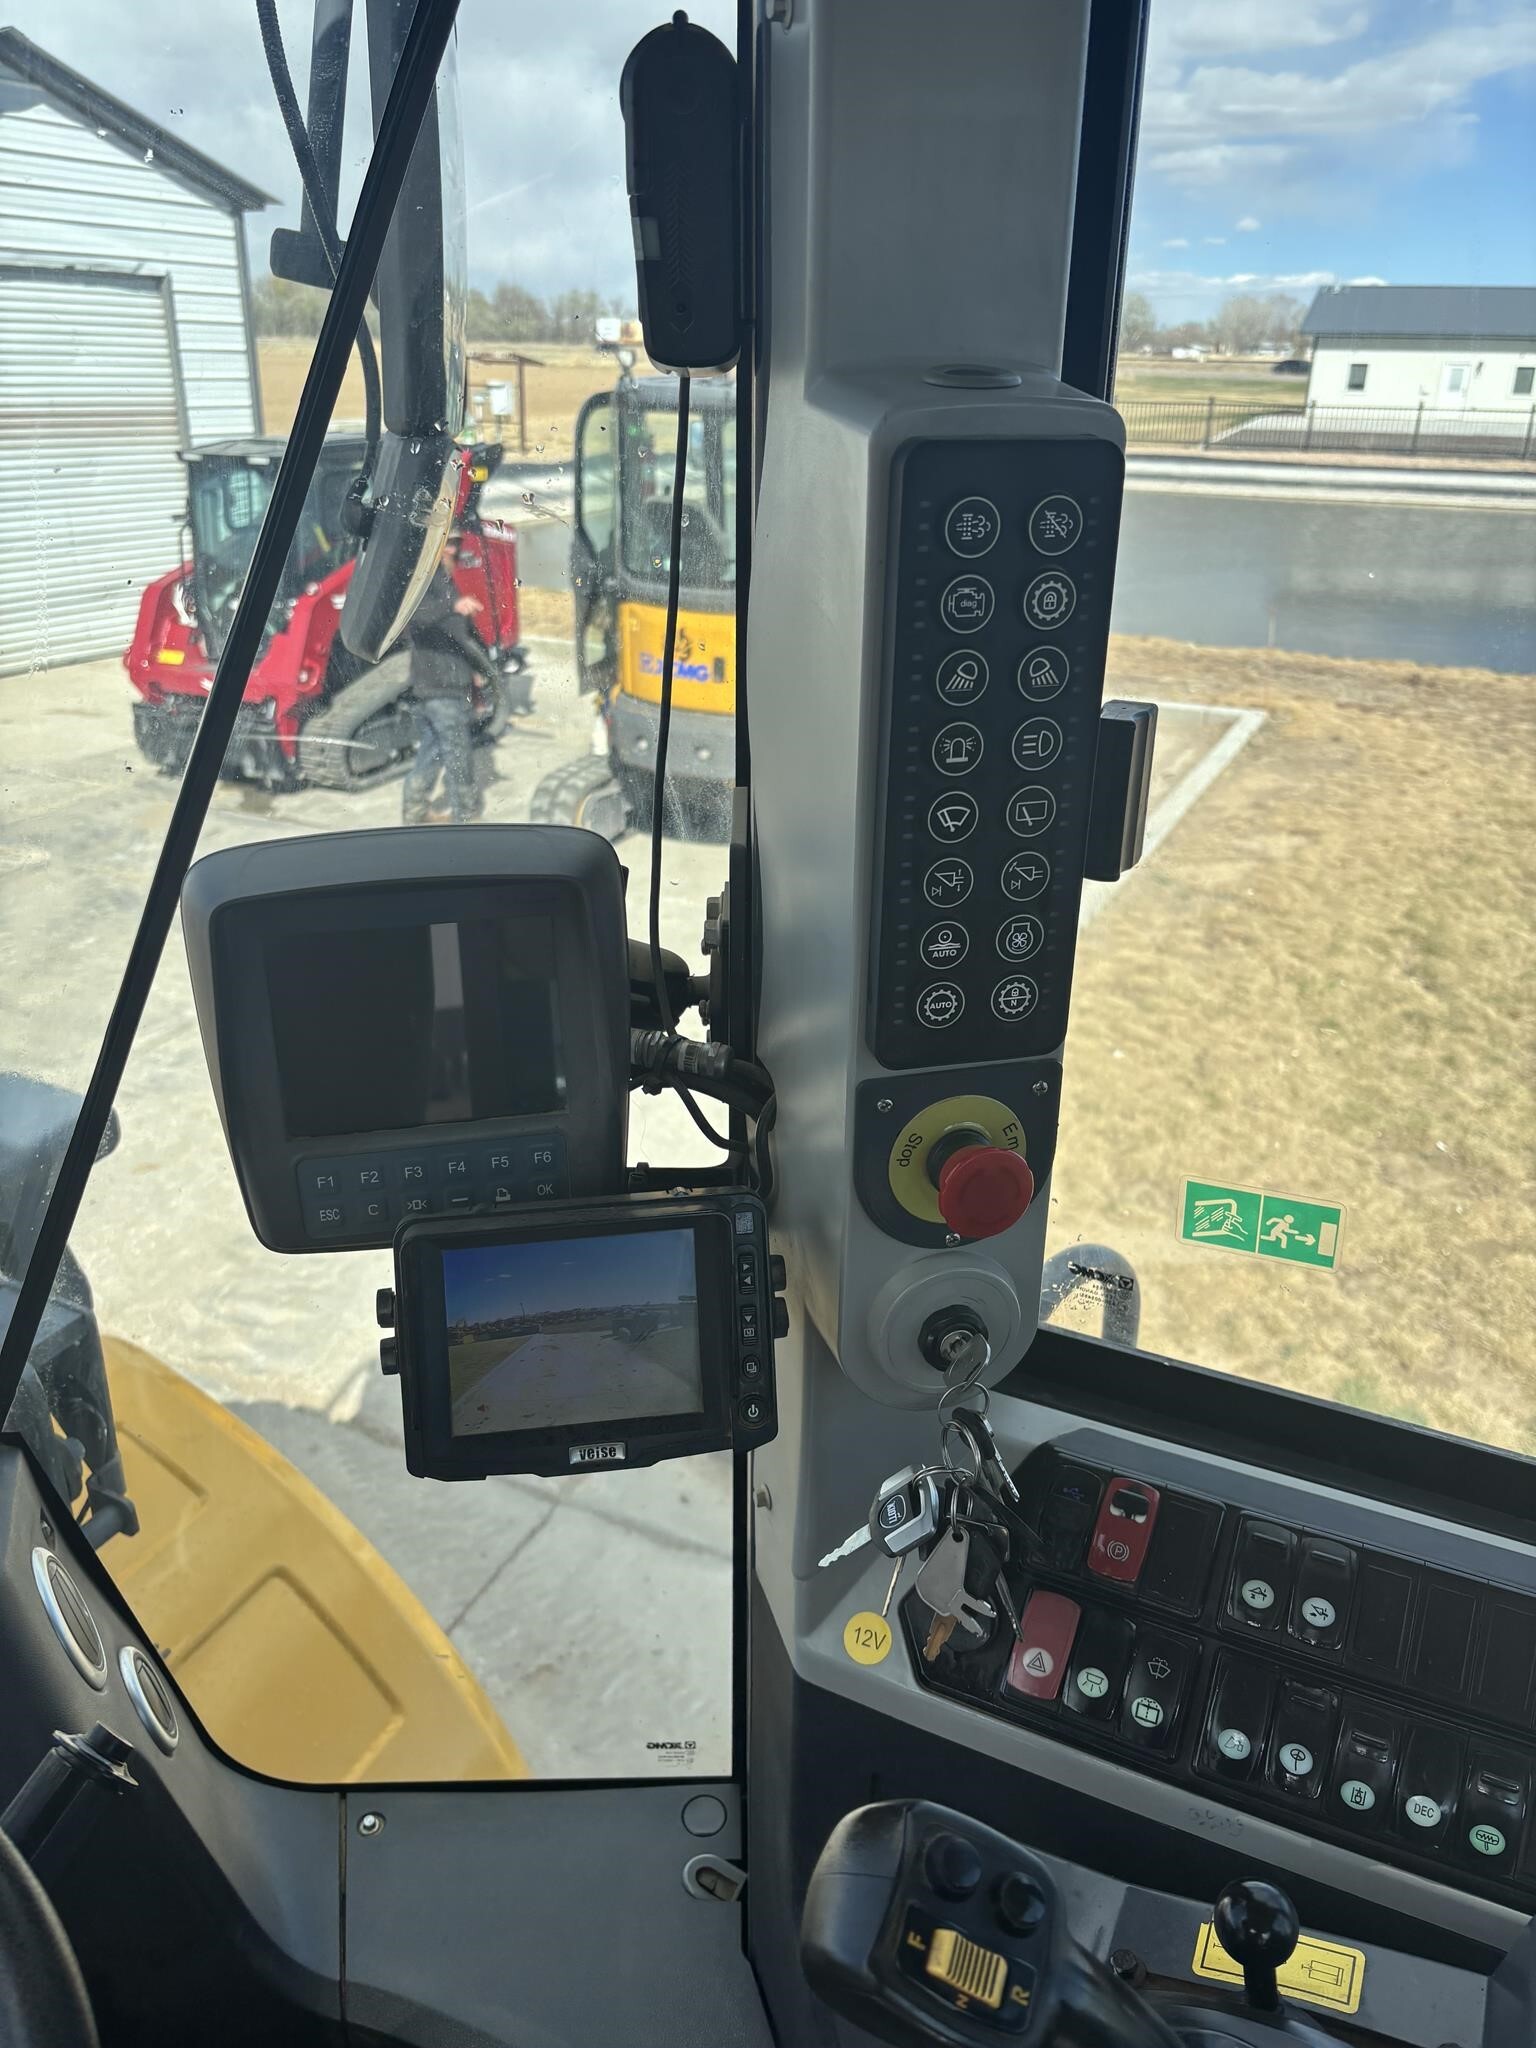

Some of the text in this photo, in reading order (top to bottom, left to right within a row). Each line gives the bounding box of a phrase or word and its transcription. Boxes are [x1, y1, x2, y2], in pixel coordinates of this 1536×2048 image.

[959, 599, 978, 610] diag
[932, 949, 957, 958] AUTO
[929, 1001, 952, 1010] AUTO
[896, 1133, 923, 1167] Stop
[491, 1156, 509, 1169] F5
[534, 1151, 552, 1164] F6
[404, 1166, 423, 1179] F3
[448, 1161, 467, 1174] F4
[317, 1175, 335, 1189] F1
[360, 1171, 380, 1184] F2
[537, 1183, 554, 1196] OK
[319, 1208, 341, 1222] ESC
[368, 1204, 378, 1216] C
[579, 1446, 617, 1460] veise
[853, 1627, 887, 1650] 12V
[1413, 1803, 1435, 1820] DEC
[907, 1931, 926, 1950] F
[1010, 1985, 1030, 2007] R
